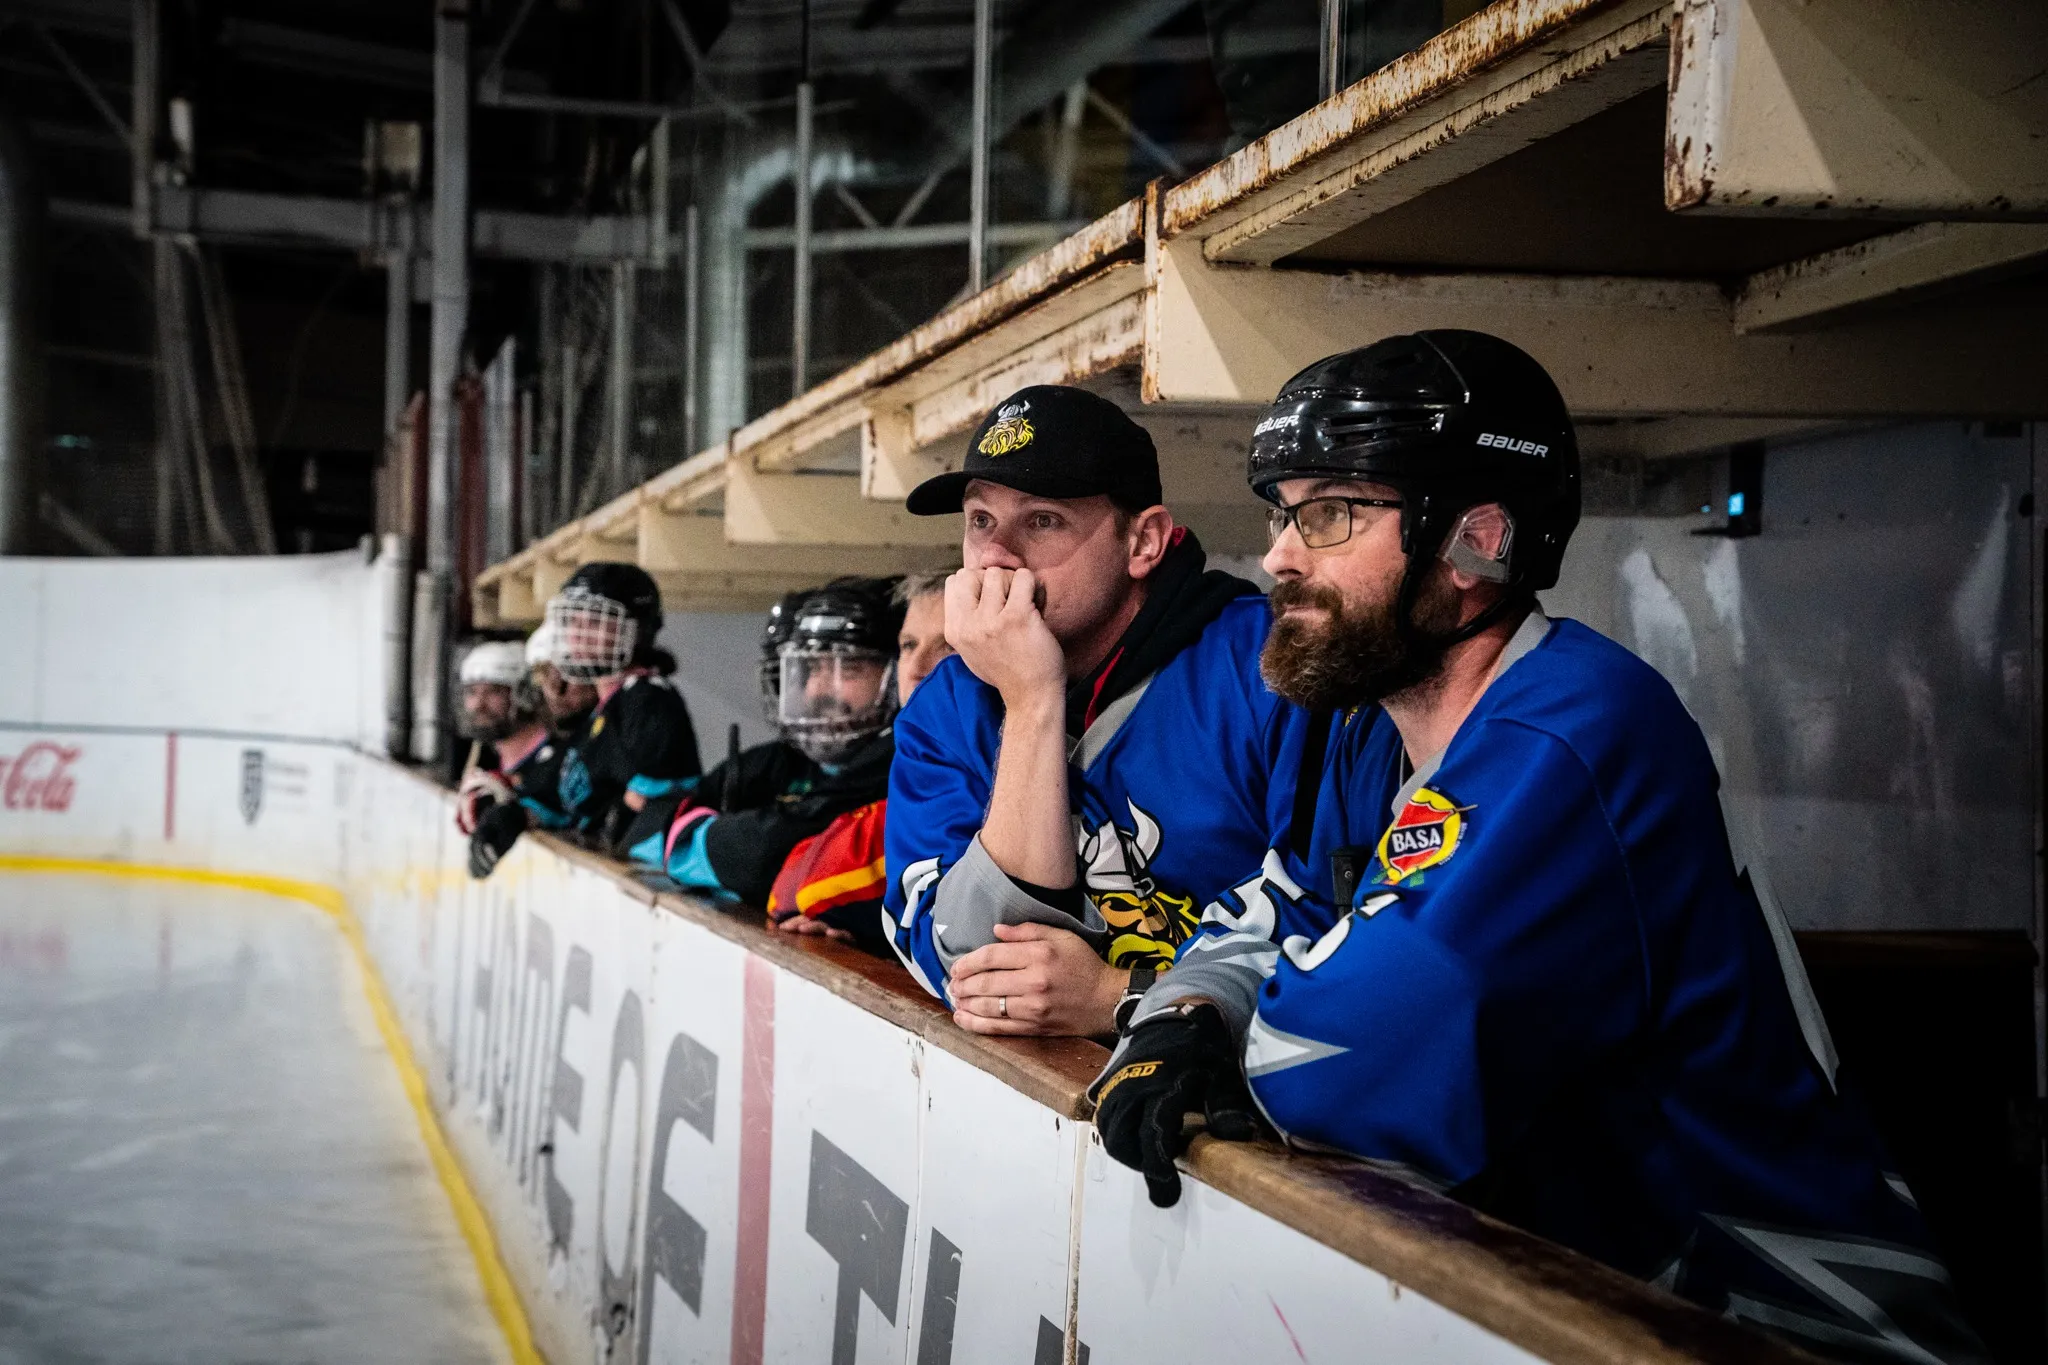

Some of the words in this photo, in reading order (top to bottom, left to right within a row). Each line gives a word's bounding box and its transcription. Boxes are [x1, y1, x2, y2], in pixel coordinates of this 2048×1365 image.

[1476, 433, 1549, 458] BAUER
[1392, 827, 1441, 853] BASA
[595, 987, 719, 1365] OF
